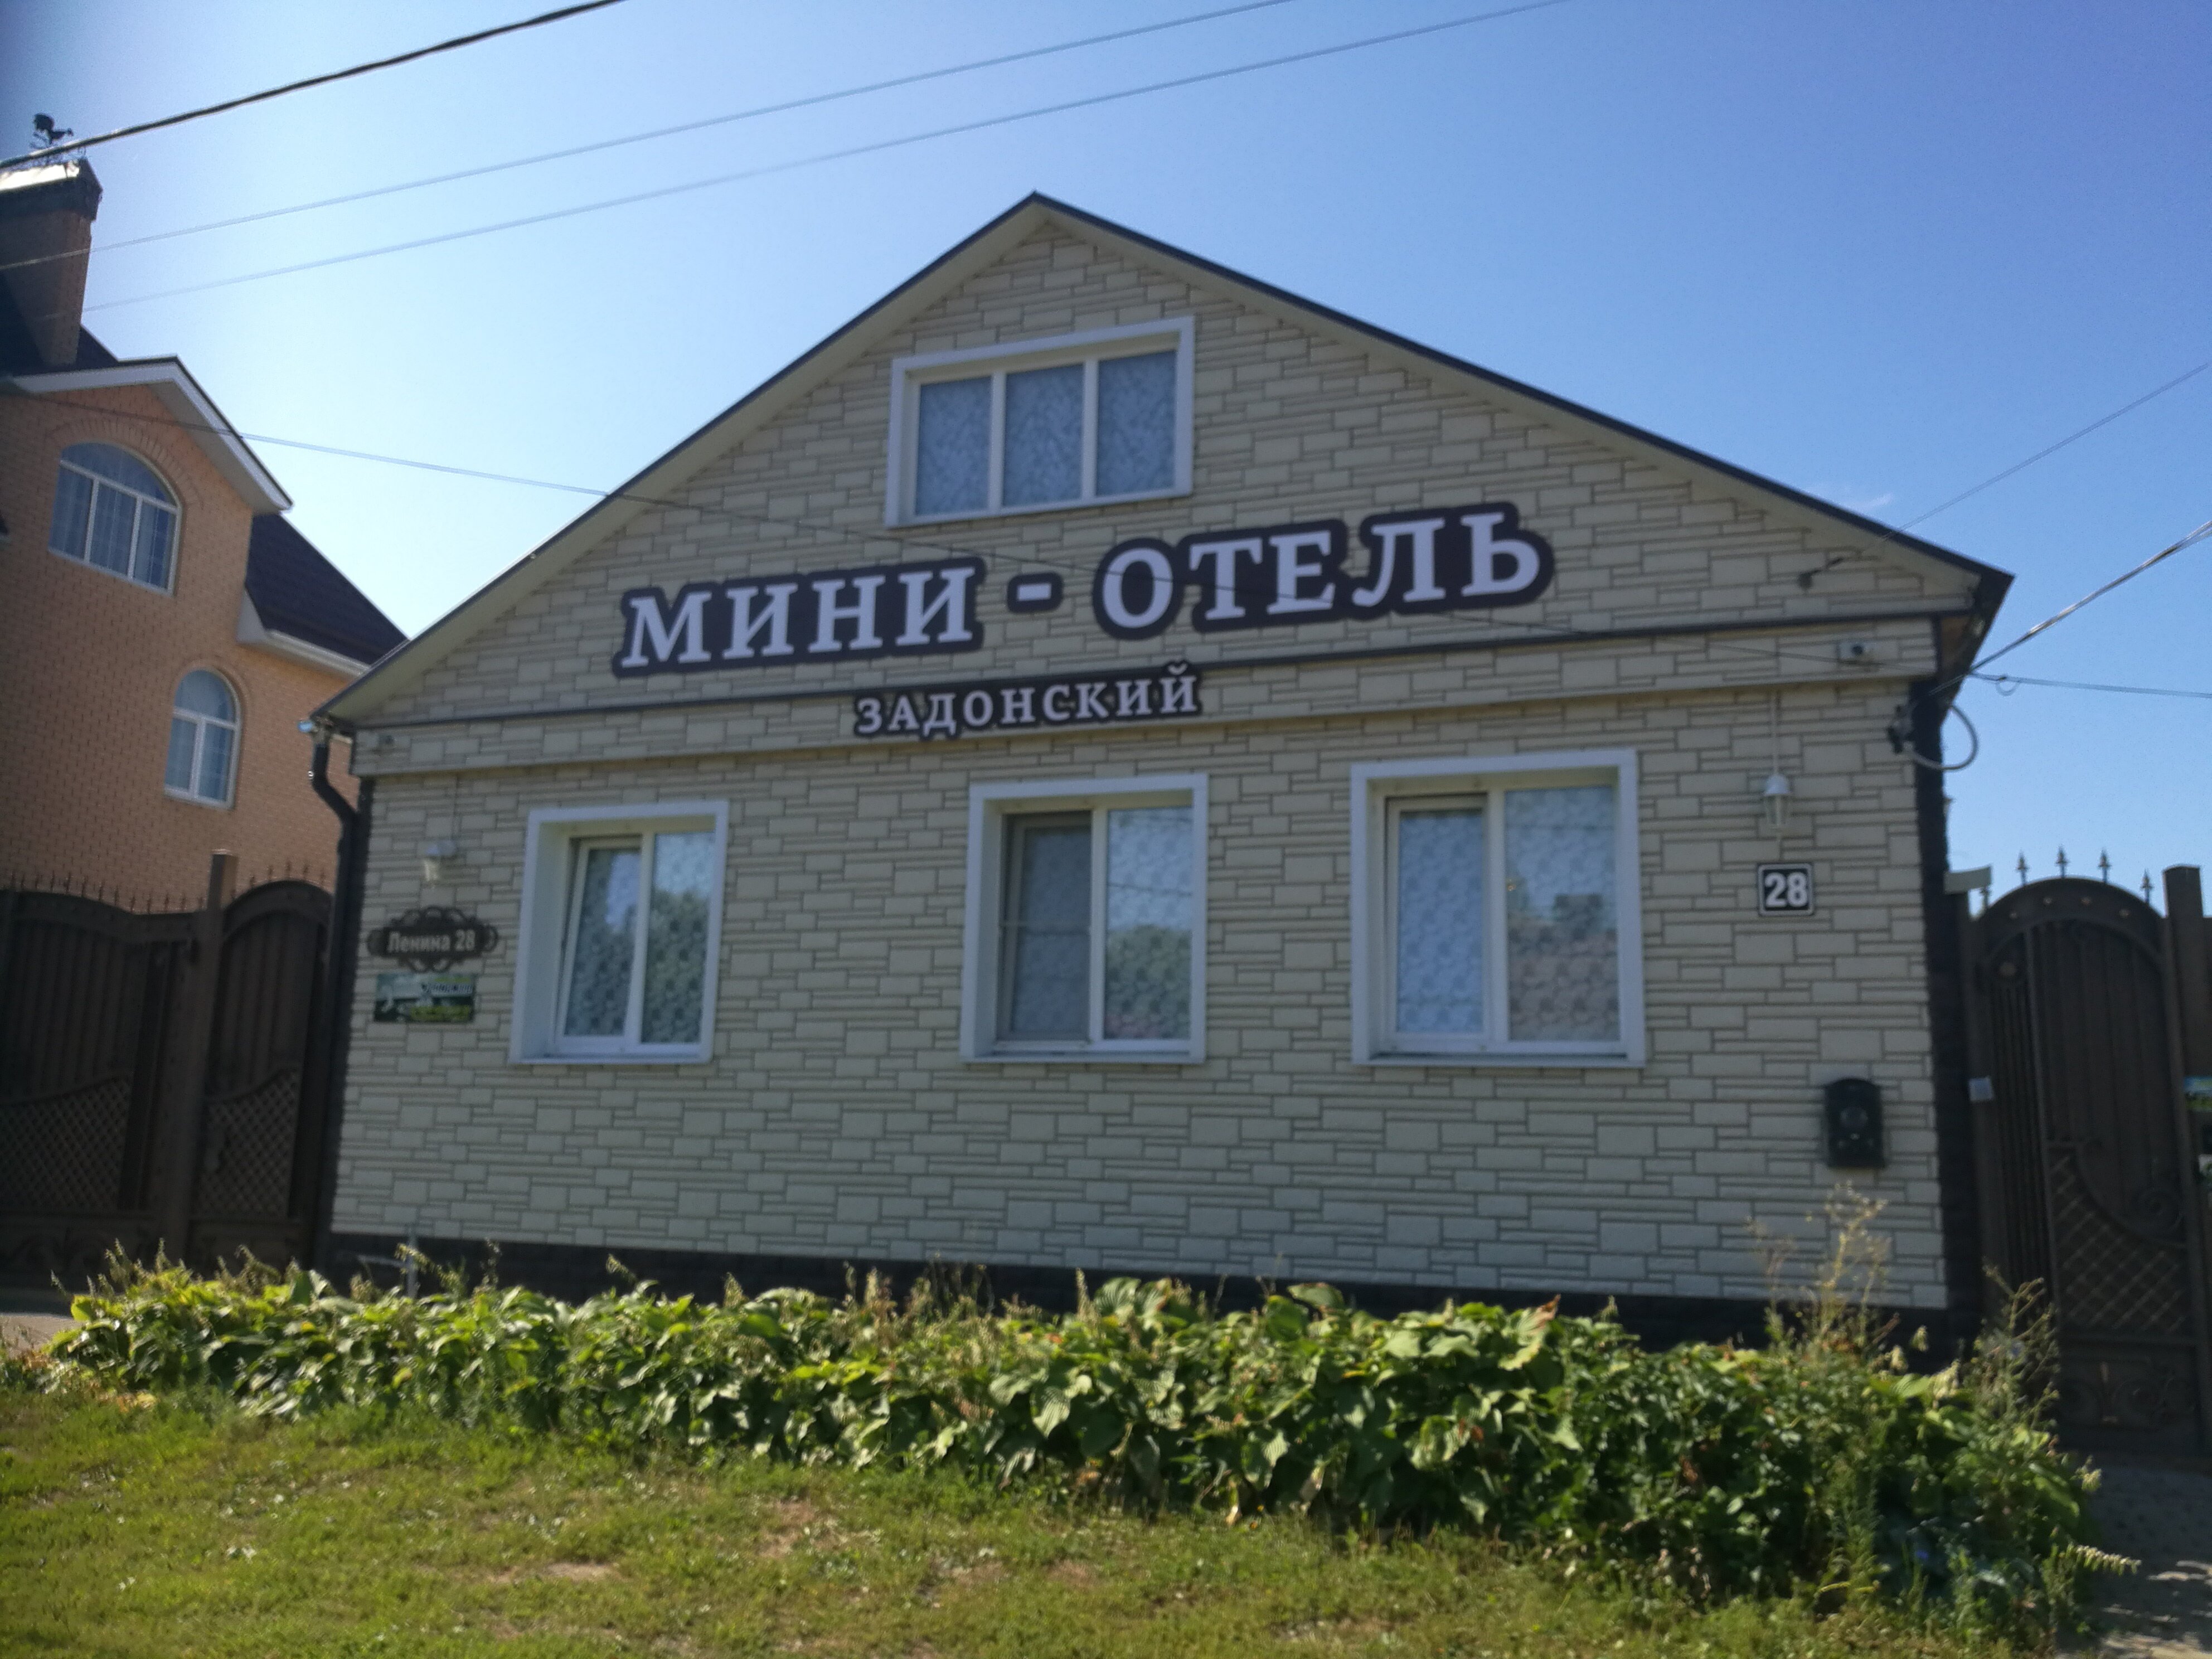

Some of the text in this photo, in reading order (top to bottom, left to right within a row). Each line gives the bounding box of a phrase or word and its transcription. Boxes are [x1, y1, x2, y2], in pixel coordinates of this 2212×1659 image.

[620, 566, 975, 668] МИНИ
[1101, 512, 1540, 629] ОТЕЛЬ
[857, 663, 1197, 737] ЗАДОНСКИЙ
[1764, 872, 1808, 907] 28
[455, 929, 476, 952] 28
